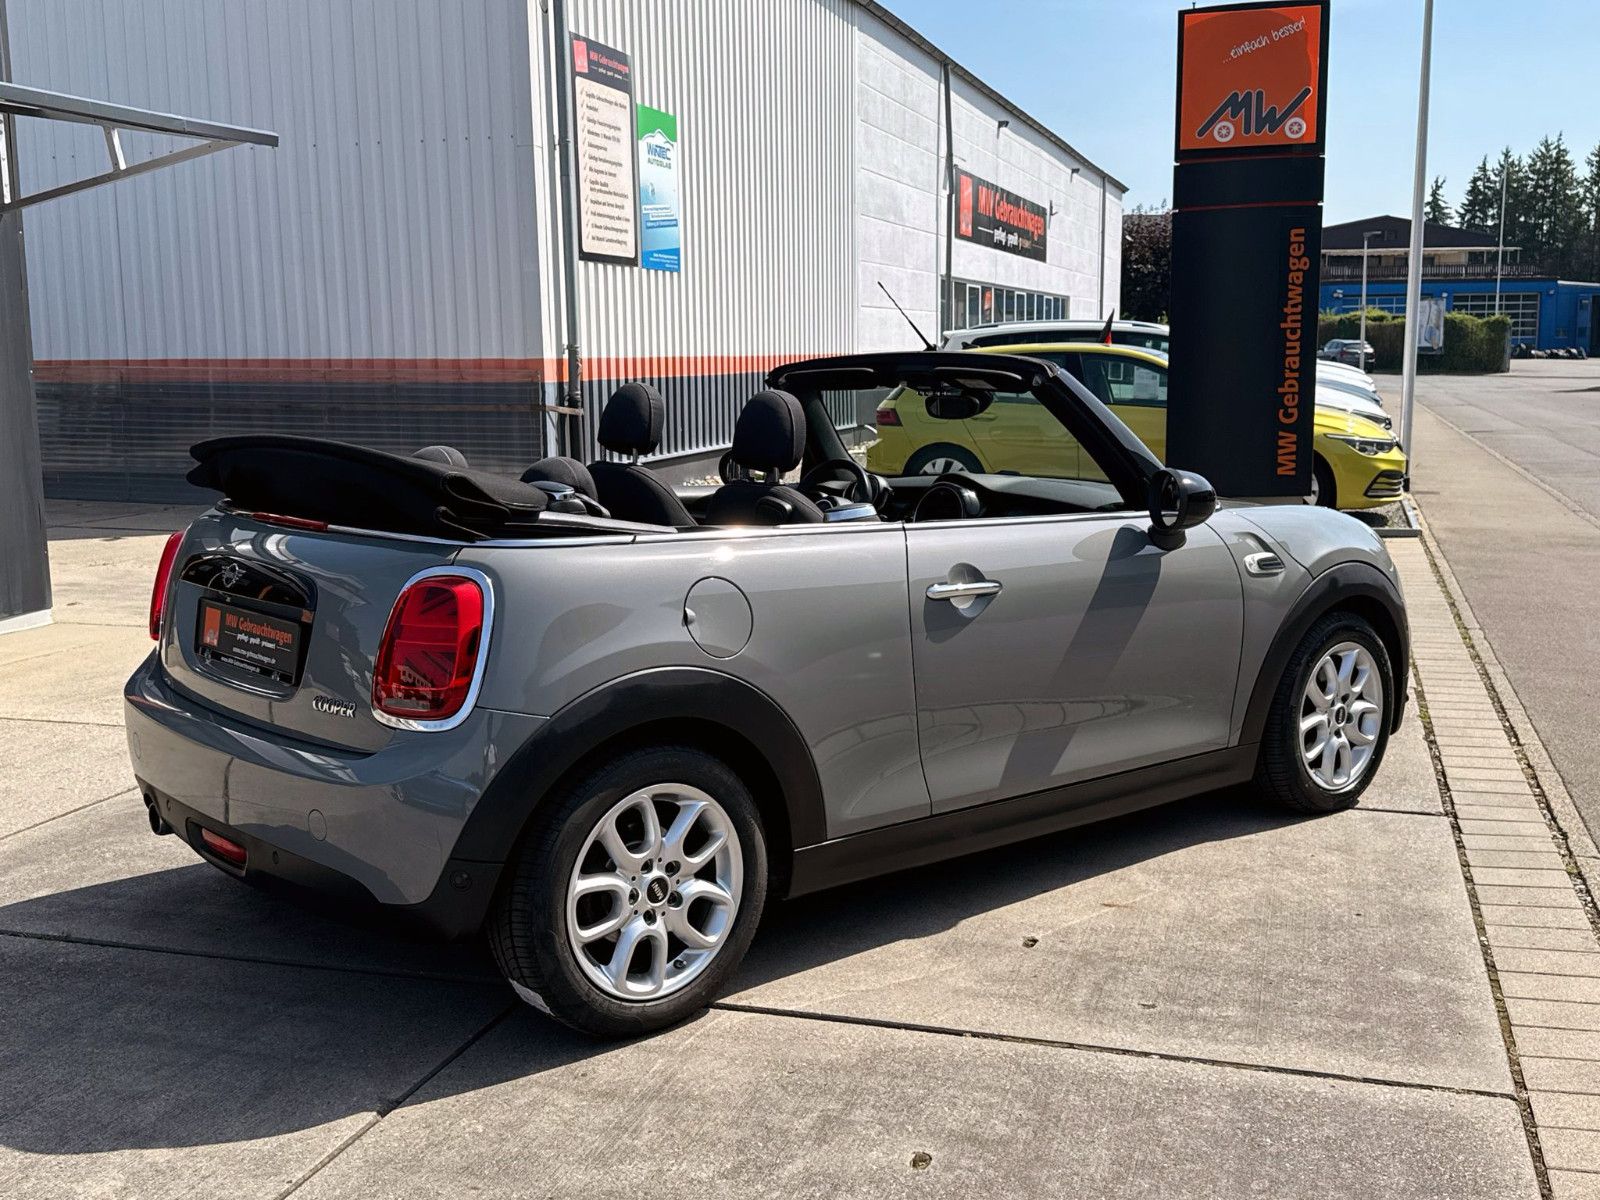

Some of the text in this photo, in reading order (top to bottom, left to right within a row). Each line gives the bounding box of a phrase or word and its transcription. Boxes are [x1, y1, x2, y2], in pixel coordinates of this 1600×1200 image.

[1196, 86, 1313, 139] MW
[978, 185, 1045, 241] MW Gebrauchtwagen
[1276, 226, 1311, 476] MW Gebrauchtwagen
[225, 612, 238, 630] MW
[238, 616, 293, 647] Gebrauchtwagen
[311, 694, 357, 719] COOPER
